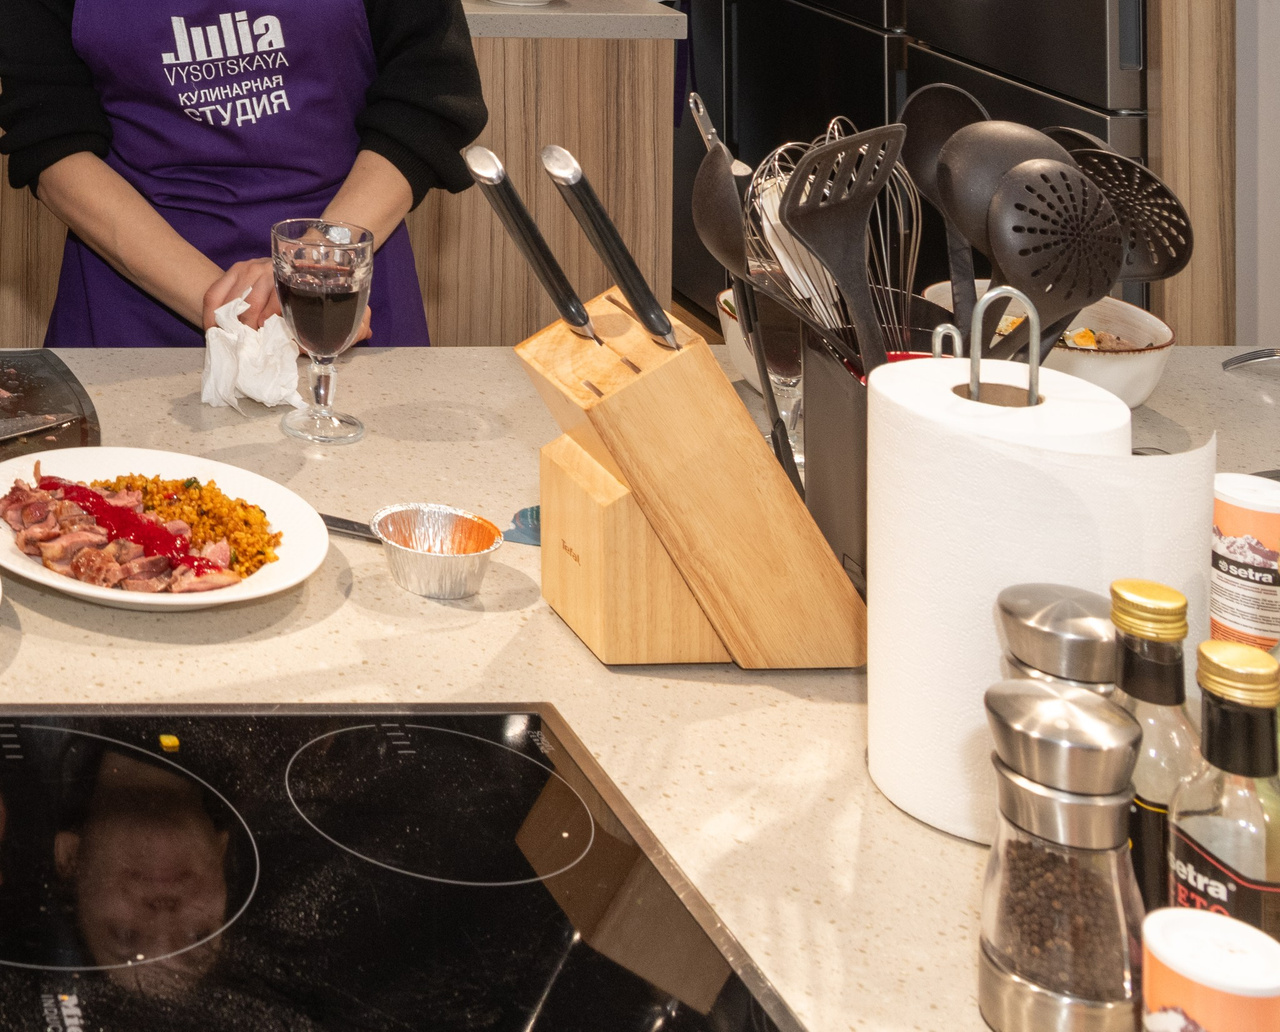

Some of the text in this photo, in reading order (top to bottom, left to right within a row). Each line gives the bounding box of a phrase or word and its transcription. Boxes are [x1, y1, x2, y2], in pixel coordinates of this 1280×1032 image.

[161, 10, 286, 65] Julia
[163, 51, 290, 87] VYSOTSKAYA
[178, 74, 284, 106] КУЛИНАРНАЯ
[183, 89, 291, 128] СТУДИЯ
[1229, 564, 1274, 585] setra
